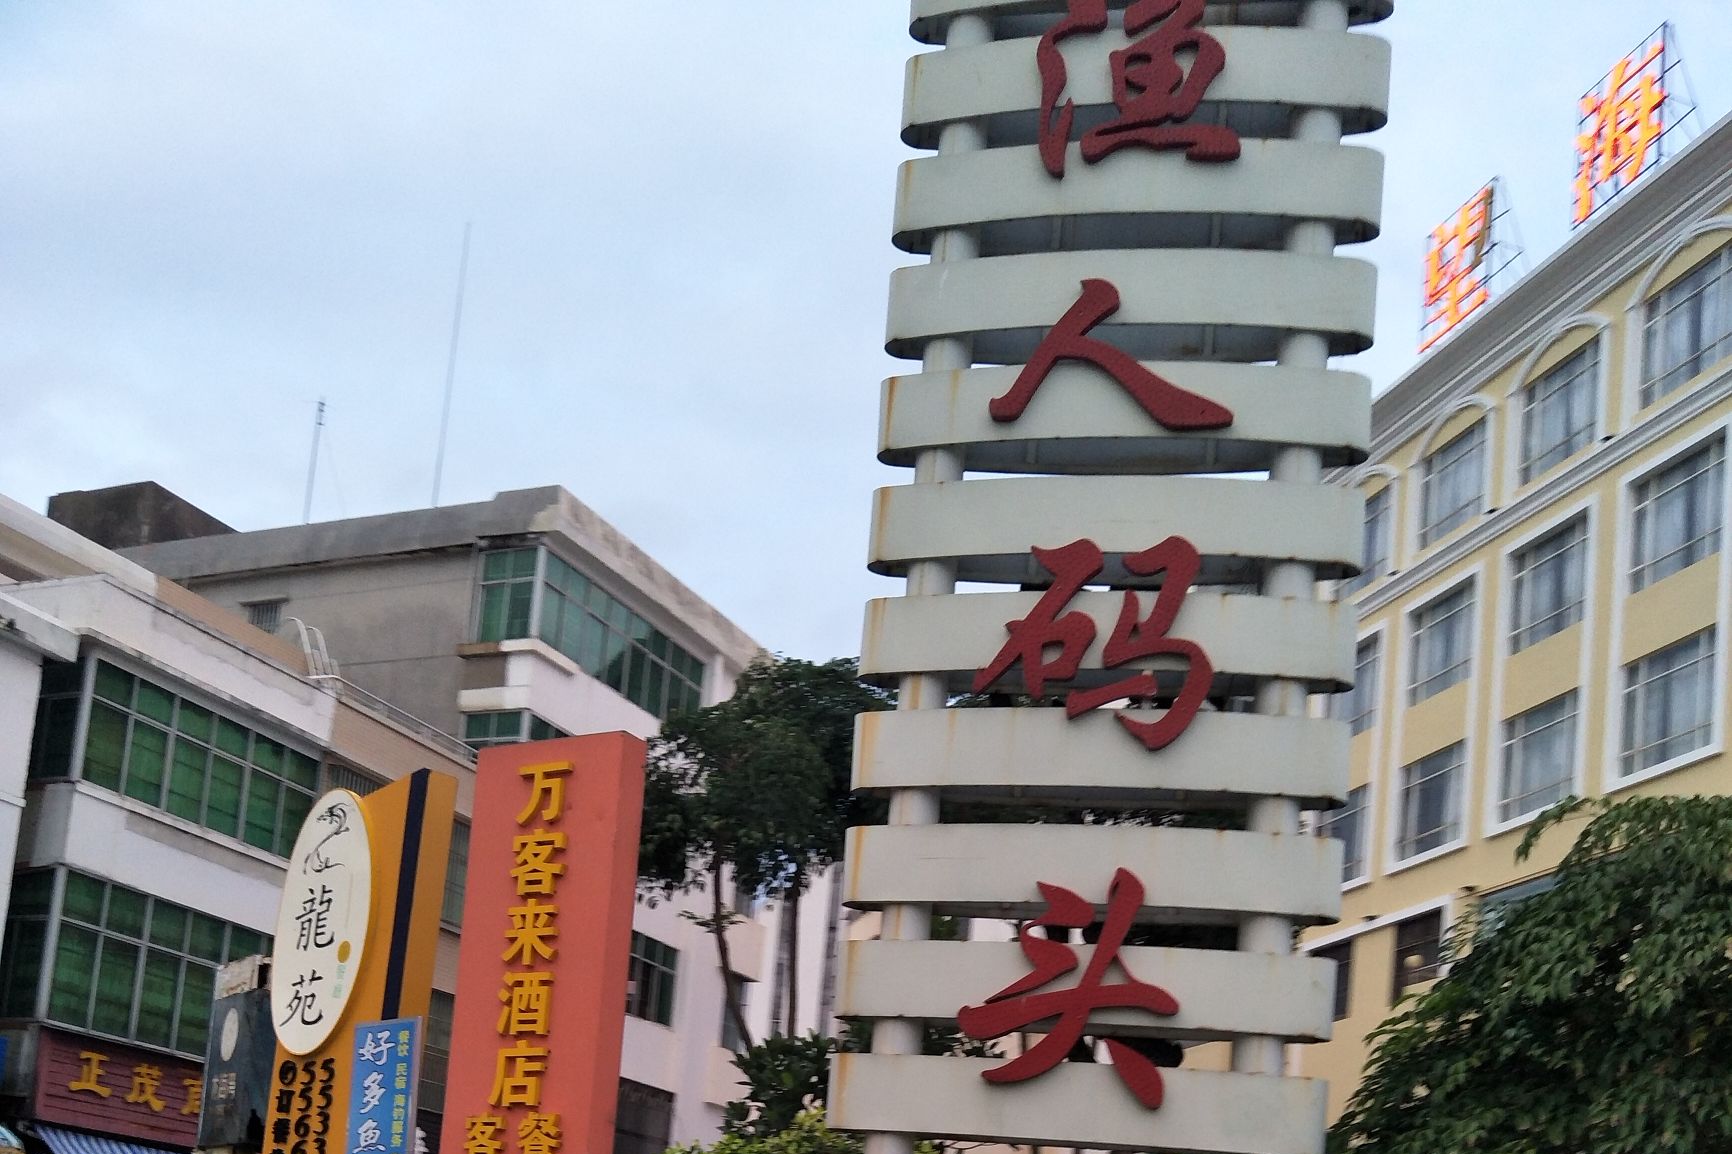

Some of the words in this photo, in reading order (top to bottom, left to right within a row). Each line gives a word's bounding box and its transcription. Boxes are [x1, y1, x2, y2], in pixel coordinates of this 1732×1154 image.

[488, 760, 574, 1108] 万客来酒店
